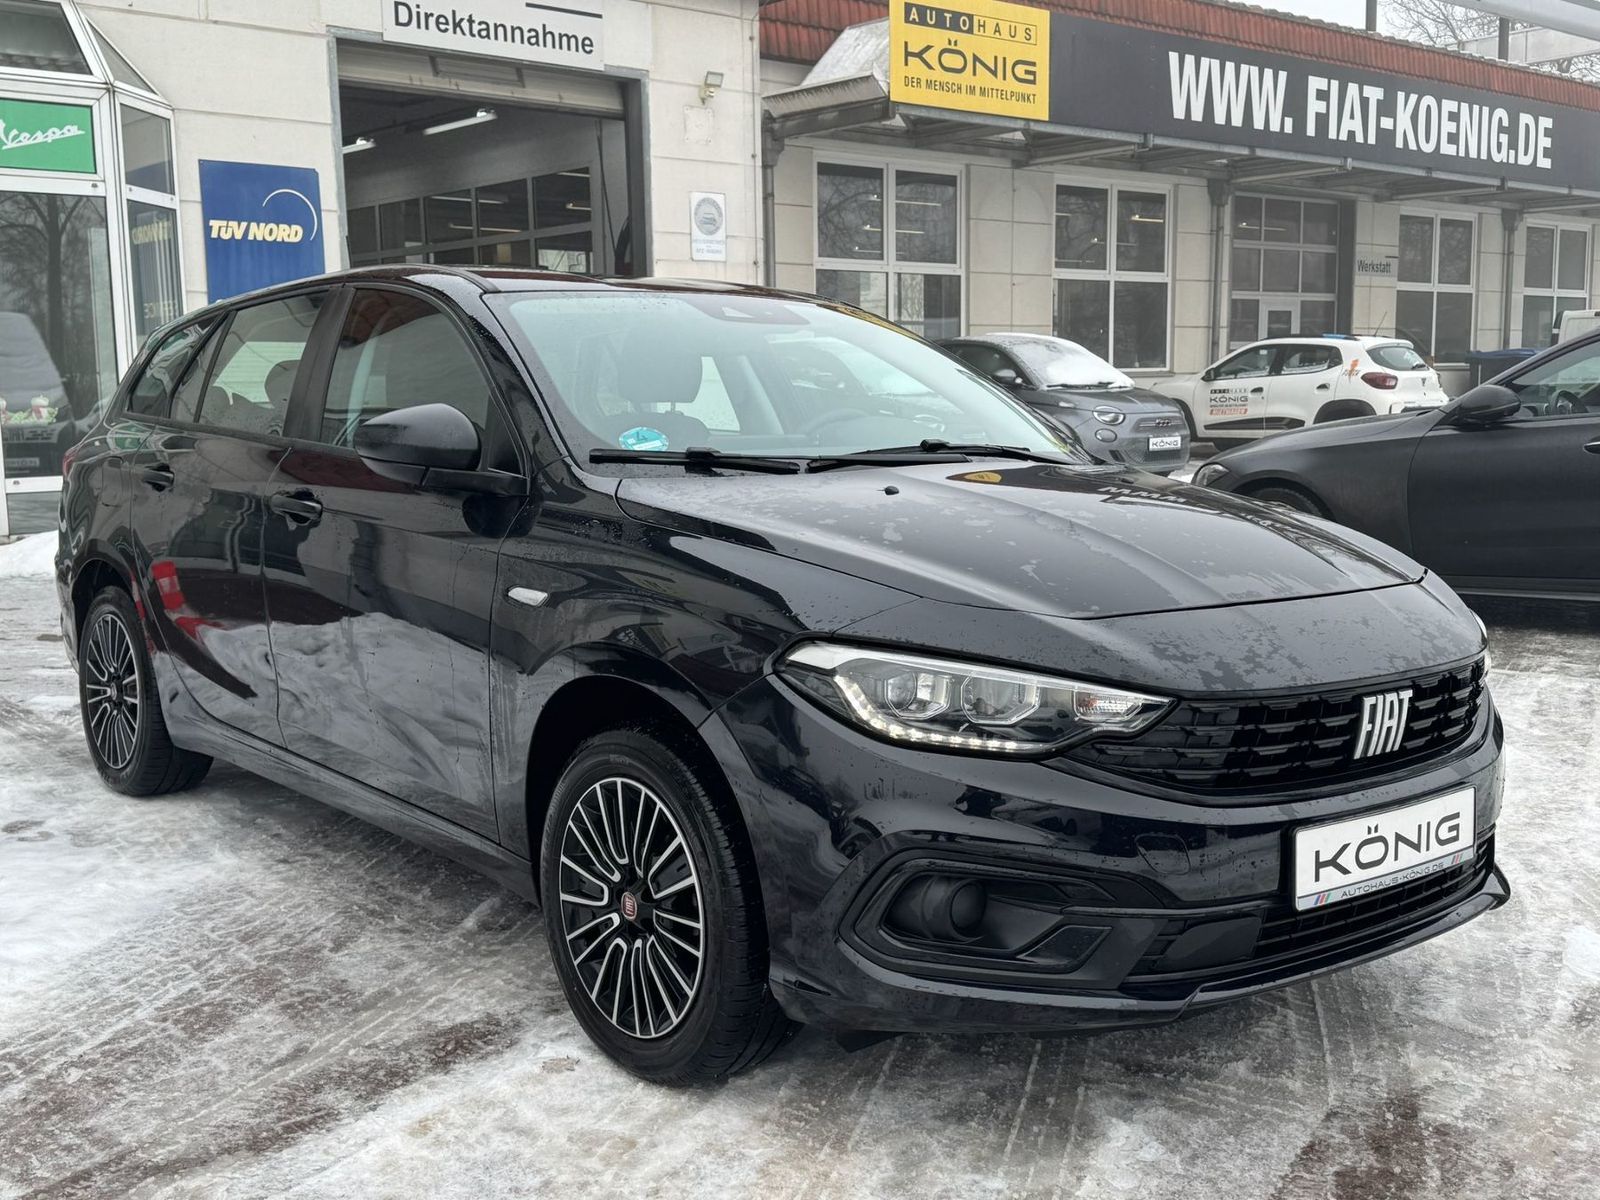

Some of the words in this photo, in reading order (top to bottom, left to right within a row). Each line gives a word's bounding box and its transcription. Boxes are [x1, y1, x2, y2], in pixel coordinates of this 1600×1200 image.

[393, 1, 594, 54] Direktannahme
[908, 6, 1033, 42] AUTOHAUS
[904, 38, 1037, 85] KÖNIG
[904, 75, 922, 89] DER
[925, 79, 962, 95] MENSCH
[965, 85, 976, 96] IM
[979, 86, 1037, 105] MITTELPUNKT
[1168, 51, 1293, 134] WWW.
[1306, 75, 1554, 169] FIAT-KOENIG.DE
[208, 219, 248, 240] TÜV
[247, 222, 304, 243] NORD
[1357, 259, 1391, 274] Werkstatt
[1151, 438, 1179, 448] KÖNIG
[1353, 689, 1413, 760] FIAT
[1314, 811, 1461, 883] KÖNIG
